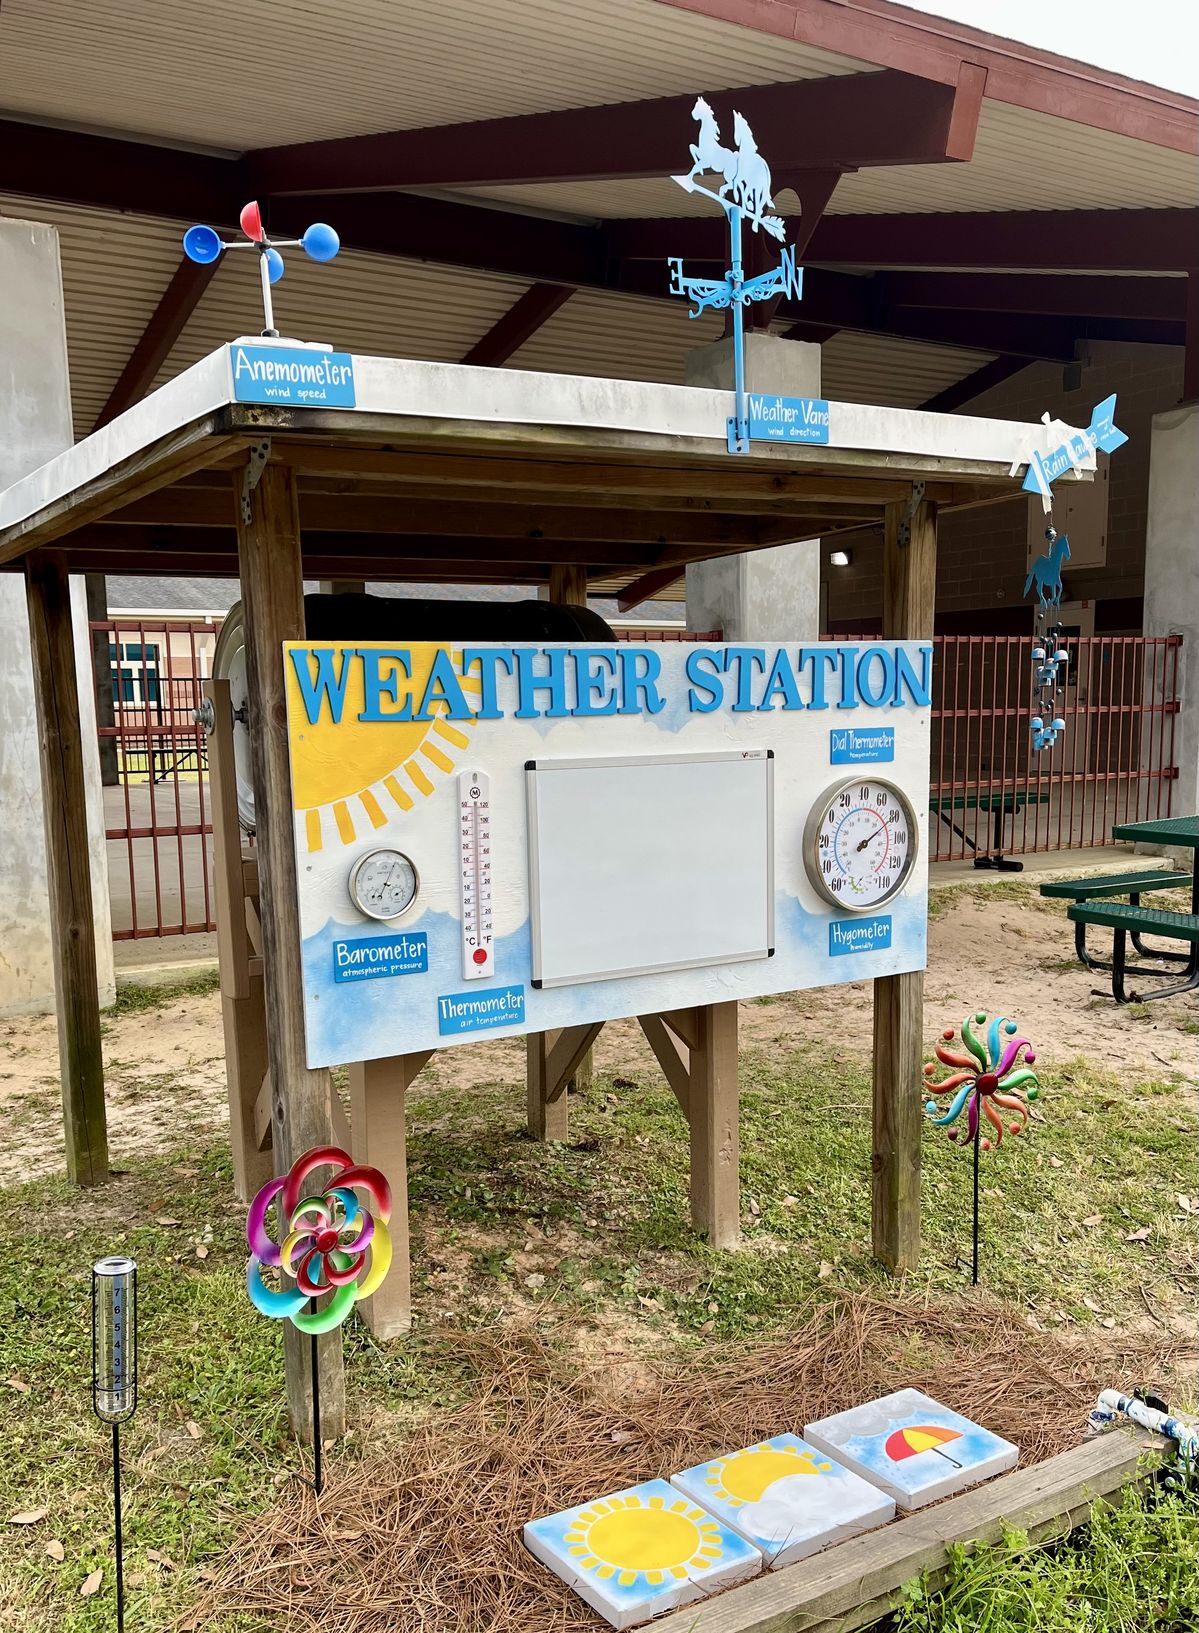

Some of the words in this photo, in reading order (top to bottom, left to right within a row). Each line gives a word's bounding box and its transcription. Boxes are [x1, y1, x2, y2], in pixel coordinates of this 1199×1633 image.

[235, 348, 352, 385] Anemometer
[265, 386, 291, 397] wind
[297, 389, 327, 401] speed
[750, 396, 798, 422] Weather
[801, 400, 828, 426] Vane
[768, 426, 784, 436] wind
[790, 426, 821, 437] direction
[1042, 453, 1068, 481] Rain
[289, 647, 666, 725] WEATHER
[686, 647, 934, 713] STATION
[832, 731, 847, 752] Dial
[848, 730, 896, 750] Thermometer
[840, 793, 851, 807] 20
[876, 793, 887, 806] 60
[829, 809, 835, 823] 0
[889, 810, 900, 823] 80
[894, 831, 906, 844] 100
[889, 856, 901, 869] 120
[483, 935, 492, 944] °F
[833, 921, 890, 945] Hygometer
[465, 937, 476, 946] °C
[337, 936, 427, 966] Barometer
[342, 965, 388, 977] atmospheric
[391, 962, 423, 974] pressure
[440, 991, 524, 1019] Thermometer
[460, 1019, 474, 1028] air
[476, 1012, 519, 1026] temperature
[114, 1288, 120, 1296] 7
[114, 1306, 120, 1314] 6
[114, 1323, 120, 1331] 5
[114, 1341, 120, 1349] 4
[114, 1358, 120, 1366] 3
[114, 1375, 120, 1384] 2
[114, 1393, 120, 1401] 1
